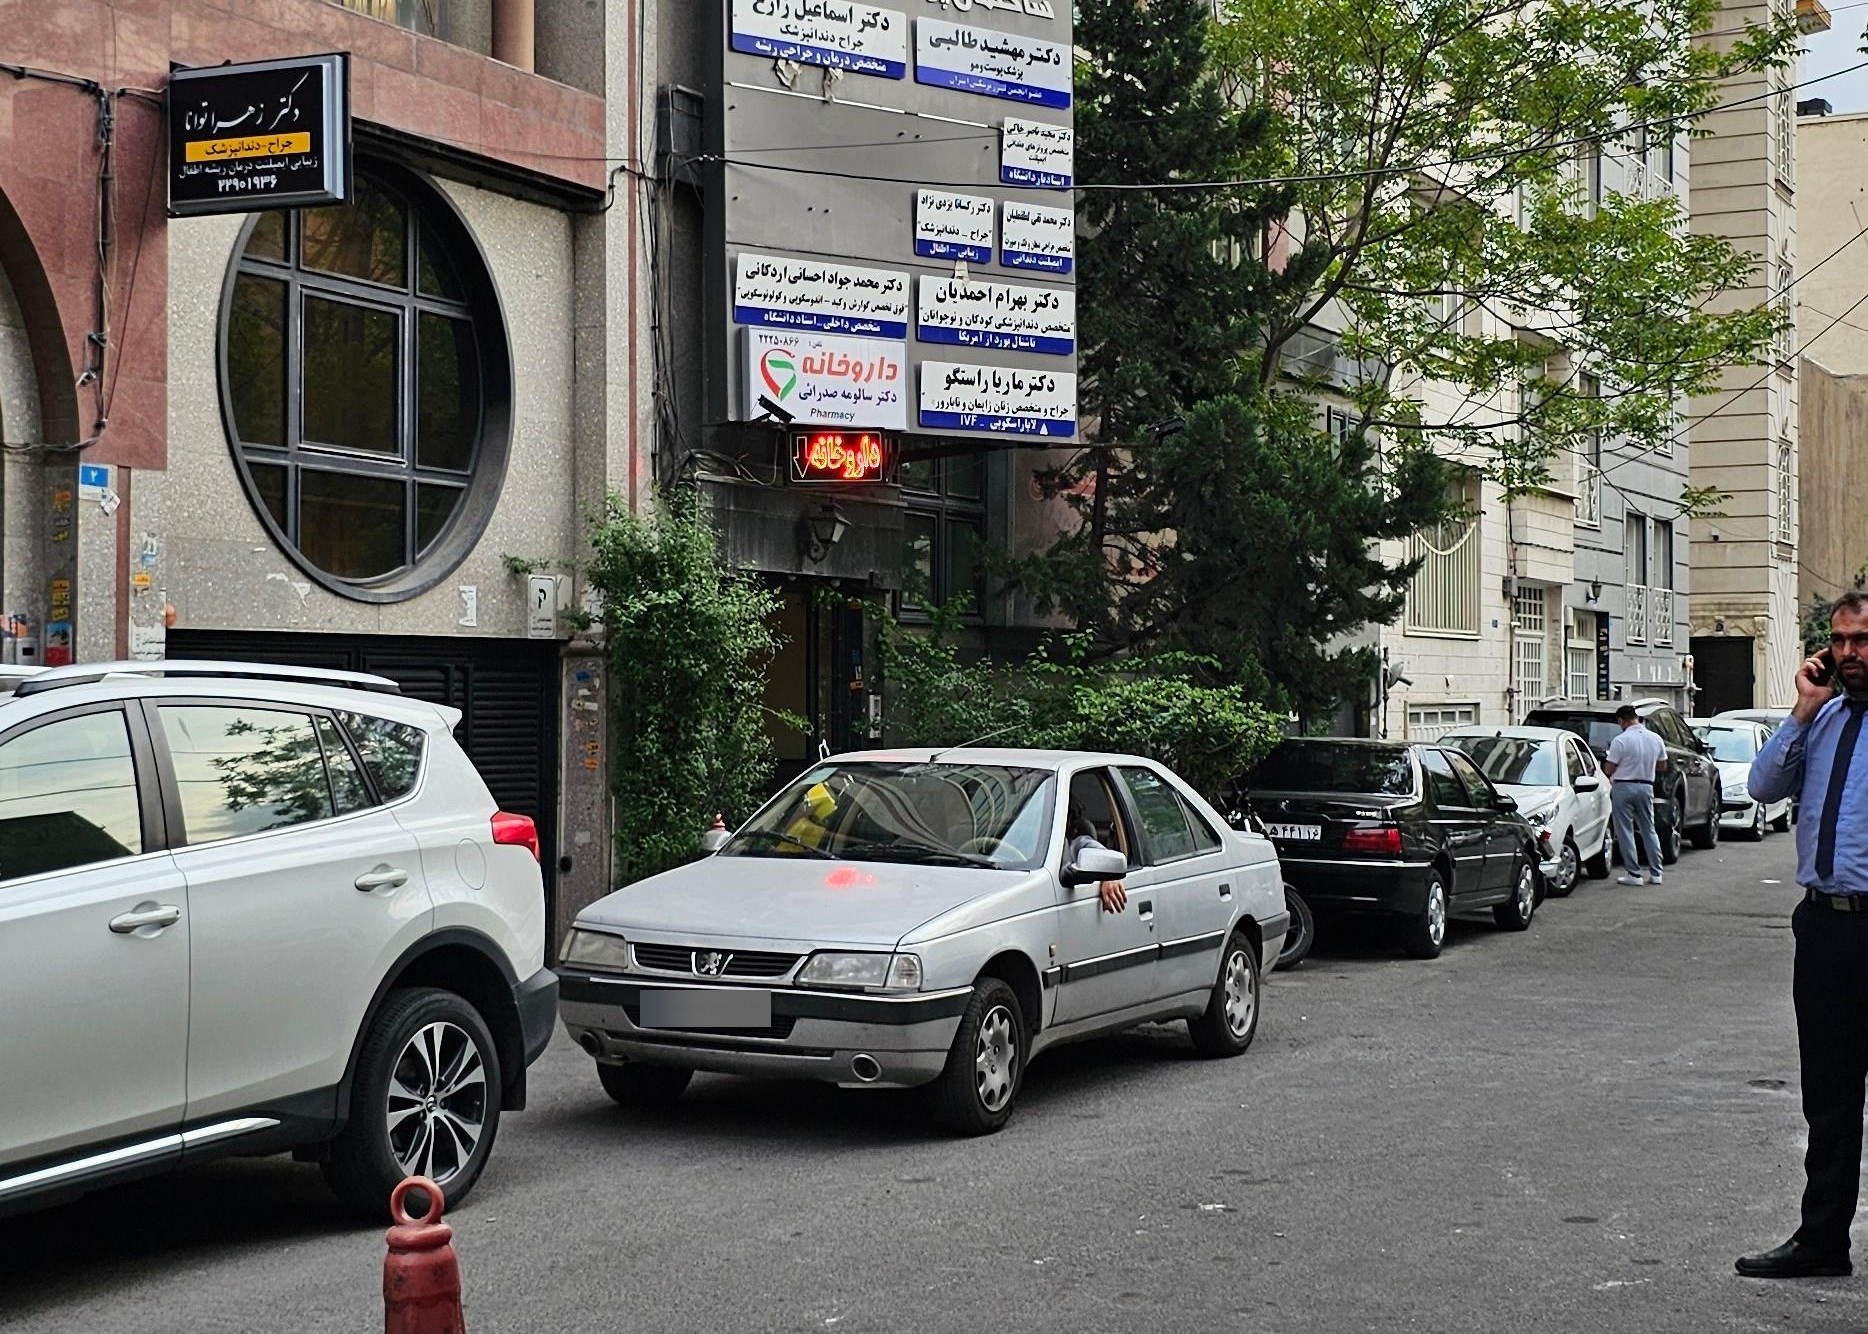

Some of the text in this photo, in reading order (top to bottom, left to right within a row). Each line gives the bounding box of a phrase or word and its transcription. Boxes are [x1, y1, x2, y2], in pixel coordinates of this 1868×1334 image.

[857, 11, 890, 33] دکتر
[780, 24, 864, 52] جراح دندانپزشک
[930, 29, 1061, 66] دکتر مهشید طالبی
[756, 40, 887, 72] متخصص درمان و جراحی ریشه
[970, 63, 979, 72] مو
[984, 63, 1004, 77] پوست
[1004, 67, 1024, 81] پزشک
[185, 70, 309, 134] دکتر زهرا توانا
[1056, 131, 1071, 143] دکتر
[205, 141, 261, 158] دندانپزشک
[268, 137, 293, 154] جراح
[179, 155, 319, 179] زیبایی ایمپلنت درمان ریشه اطفال
[1008, 168, 1036, 182] دانشگاه
[218, 174, 278, 192] ۲۲۹۰۱۹۳۶
[976, 201, 991, 215] دکتر
[920, 220, 960, 238] دندانپزشک
[1058, 216, 1071, 230] دکتر
[970, 226, 989, 242] جراح
[1012, 252, 1037, 265] دندانی
[745, 261, 903, 294] دکتر محمد جواد احسانی اردکانی
[788, 292, 824, 307] اندوسکوپی
[831, 296, 843, 308] کبد
[935, 281, 1059, 313] دکتر بهرام احمدیان
[870, 301, 892, 313] تخصص
[893, 303, 905, 316] فوق
[763, 310, 796, 323] دانشگاه
[796, 315, 817, 326] استاد
[823, 317, 849, 330] داخلی
[922, 308, 957, 325] نوجوانان
[965, 313, 994, 328] کودکان
[995, 315, 1039, 332] دندانپزشکی
[850, 321, 881, 334] متخصص
[1041, 321, 1071, 334] متخصص
[958, 330, 984, 344] آمریکا
[985, 333, 993, 345] از
[994, 335, 1011, 348] بورد
[802, 351, 898, 384] داروخانه
[943, 366, 1056, 396] دکتر ماریا راستگو
[841, 387, 873, 405] سالومه
[875, 390, 897, 407] دکتر
[968, 399, 992, 413] زایمان
[993, 399, 1011, 415] زنان
[1011, 402, 1042, 415] متخصص
[1049, 403, 1069, 418] جراح
[810, 407, 856, 423] Pharmacy
[960, 414, 978, 427] IVF
[989, 417, 1037, 433] لاپاراسکوپی
[810, 434, 882, 479] داروخانه
